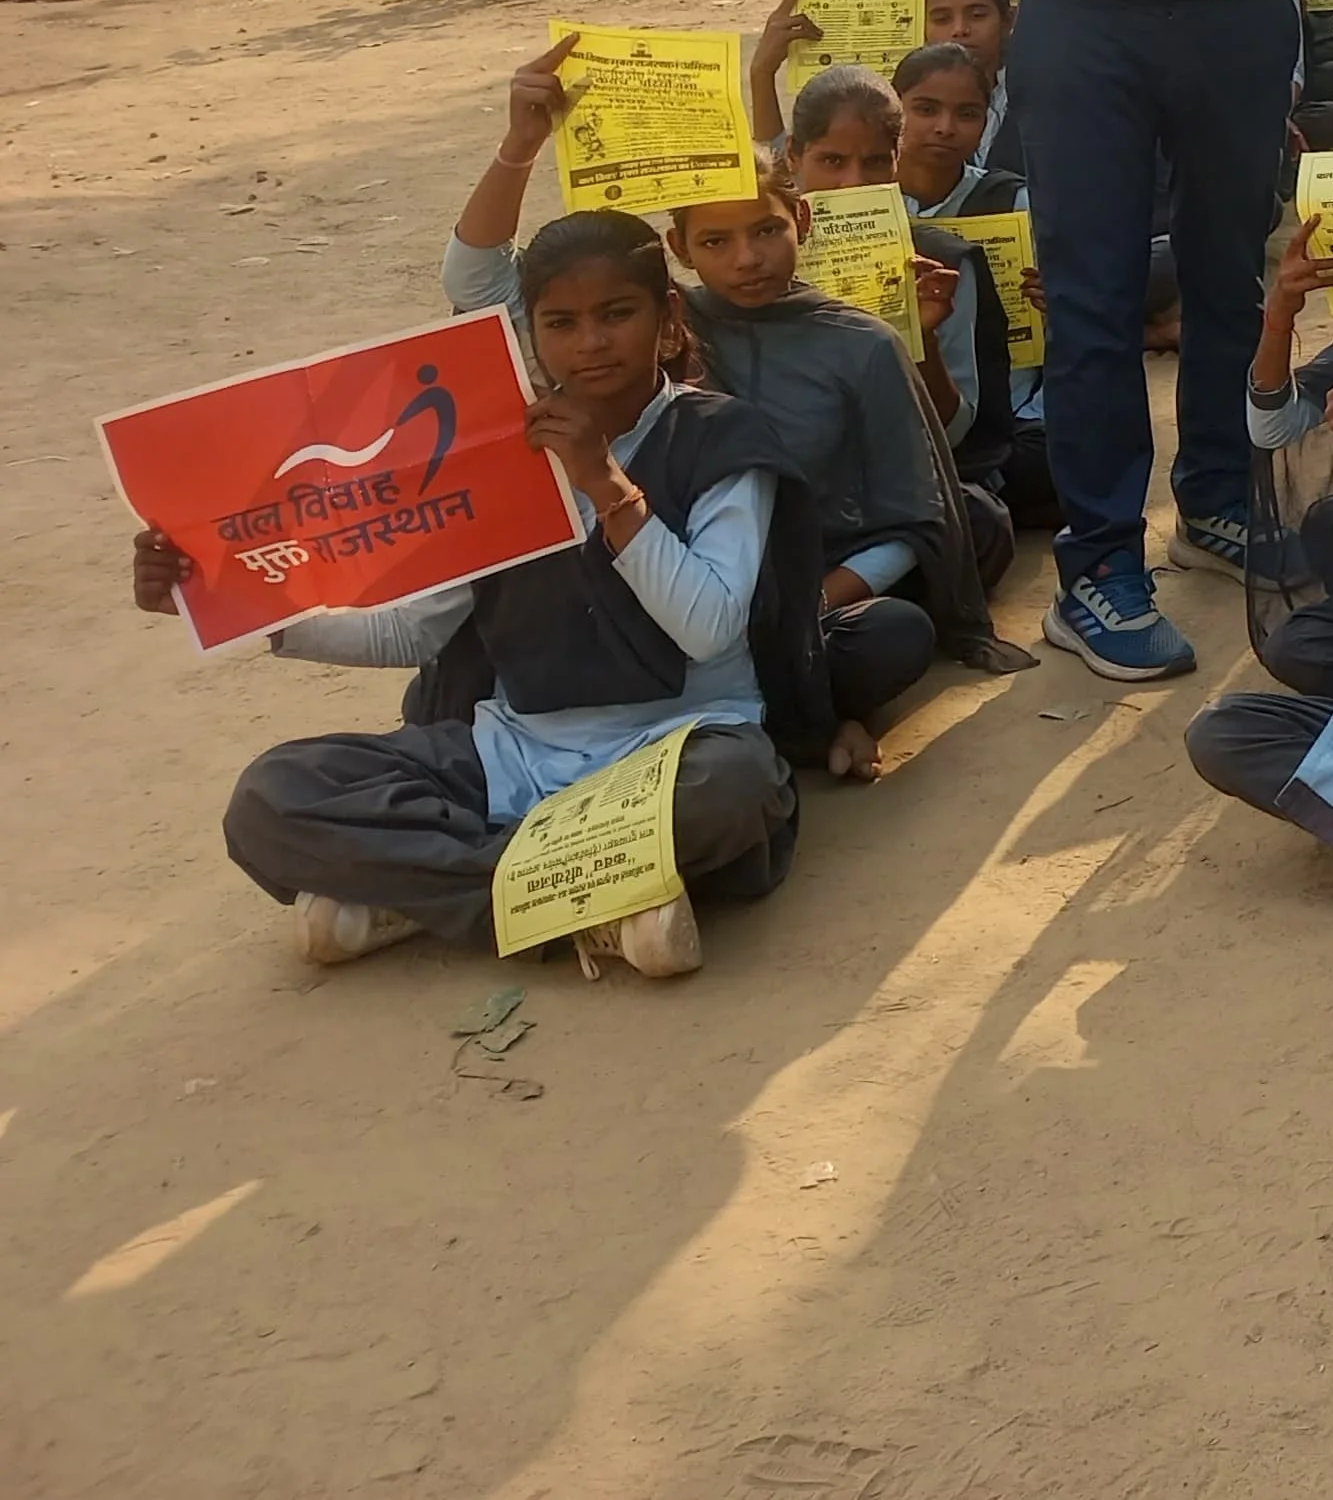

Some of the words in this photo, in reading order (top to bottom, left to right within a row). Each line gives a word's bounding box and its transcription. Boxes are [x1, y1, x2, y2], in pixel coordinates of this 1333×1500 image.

[209, 500, 284, 543] बाल
[286, 469, 400, 528] विवाह
[234, 539, 310, 584] मुक्त
[303, 488, 476, 564] राजस्थान
[527, 865, 584, 893] परियोजना
